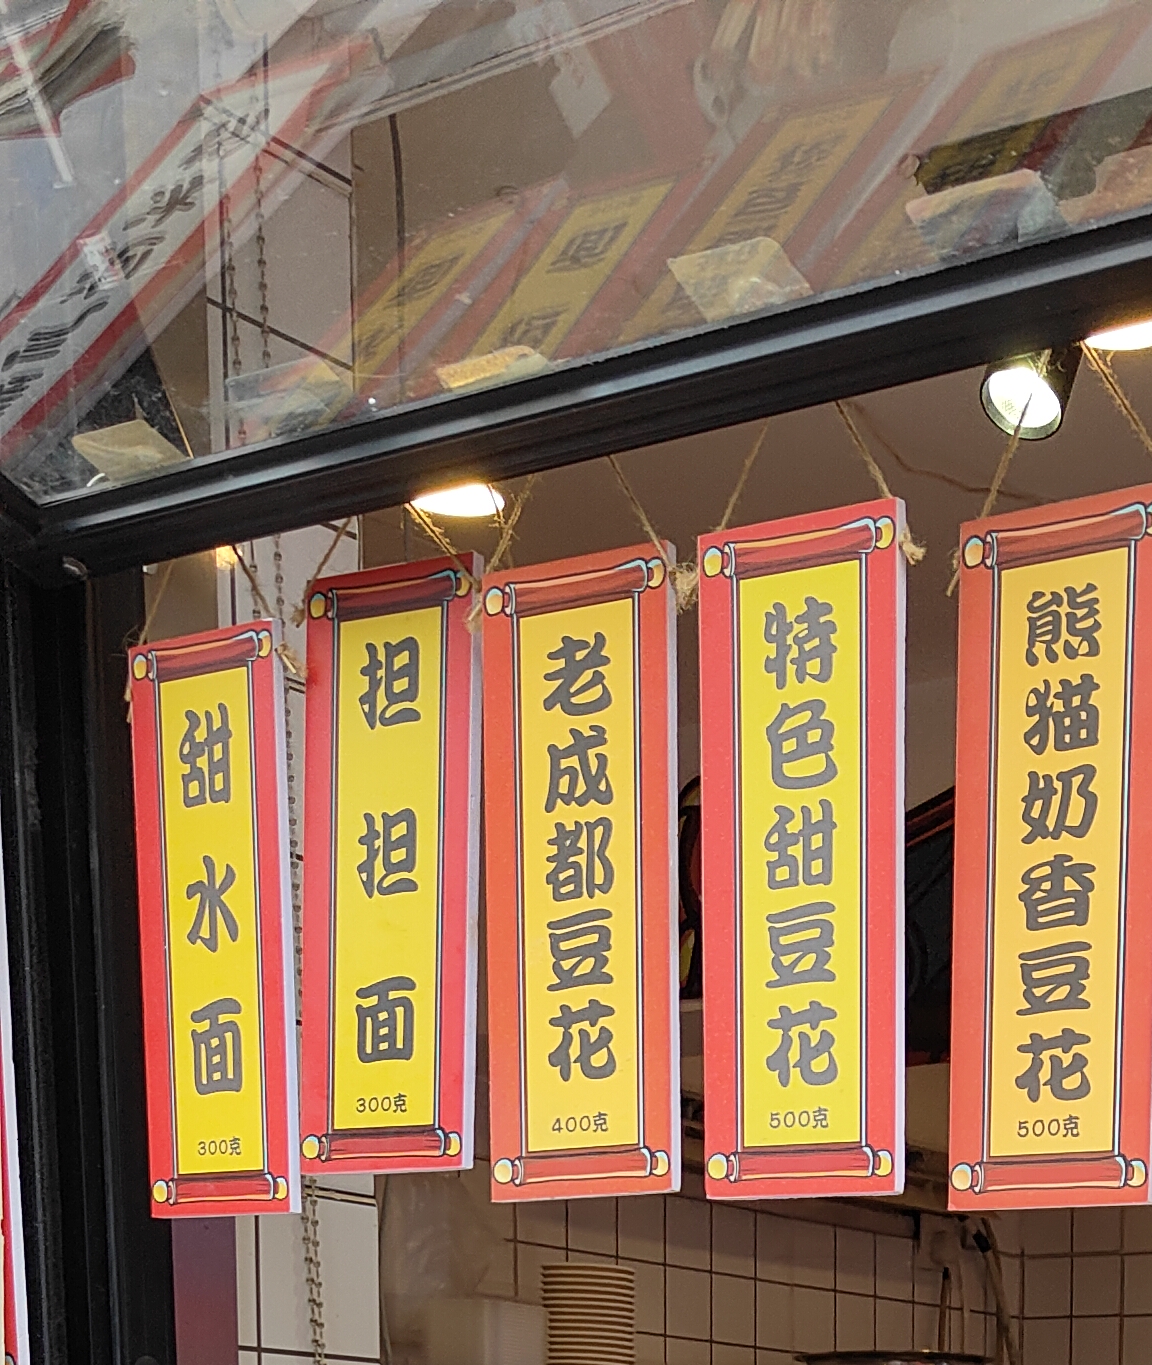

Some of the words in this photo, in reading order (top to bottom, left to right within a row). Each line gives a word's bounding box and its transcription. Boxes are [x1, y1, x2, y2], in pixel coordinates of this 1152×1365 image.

[178, 702, 244, 1097] 甜水面
[355, 636, 421, 1064] 担担面
[543, 631, 617, 1082] 老成都豆花
[763, 596, 839, 1088] 特色甜豆花
[1014, 582, 1102, 1103] 熊猫奶香豆花
[197, 1136, 242, 1157] 300克
[356, 1093, 408, 1113] 300克
[551, 1111, 609, 1133] 400克
[768, 1106, 829, 1129] 500克
[1016, 1114, 1080, 1138] 500克
